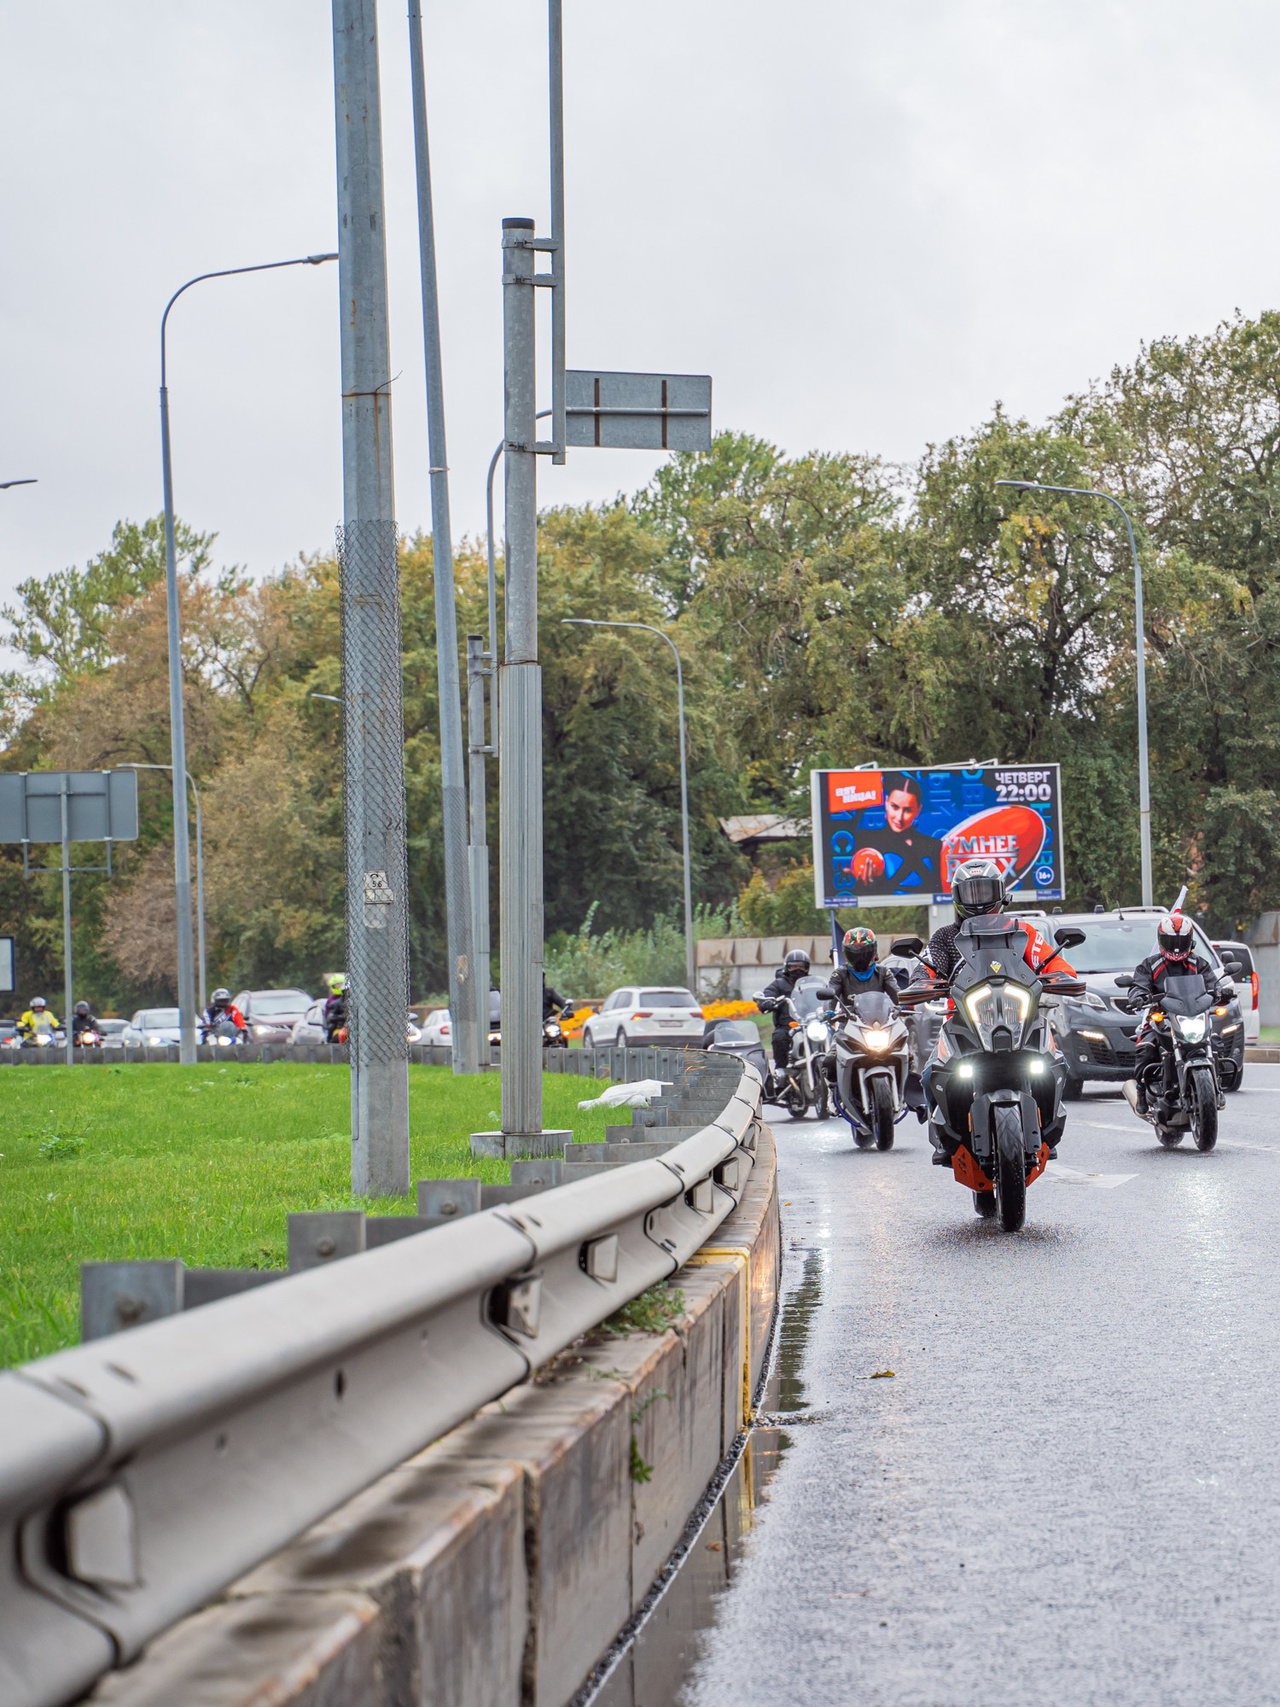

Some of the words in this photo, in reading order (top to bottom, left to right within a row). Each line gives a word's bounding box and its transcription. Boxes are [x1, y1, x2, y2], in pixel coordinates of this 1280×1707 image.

[995, 771, 1050, 784] ЧЕТВЕРГ
[996, 784, 1051, 801] 22:00
[945, 835, 1019, 853] УМНЕЕ
[372, 880, 382, 888] 56
